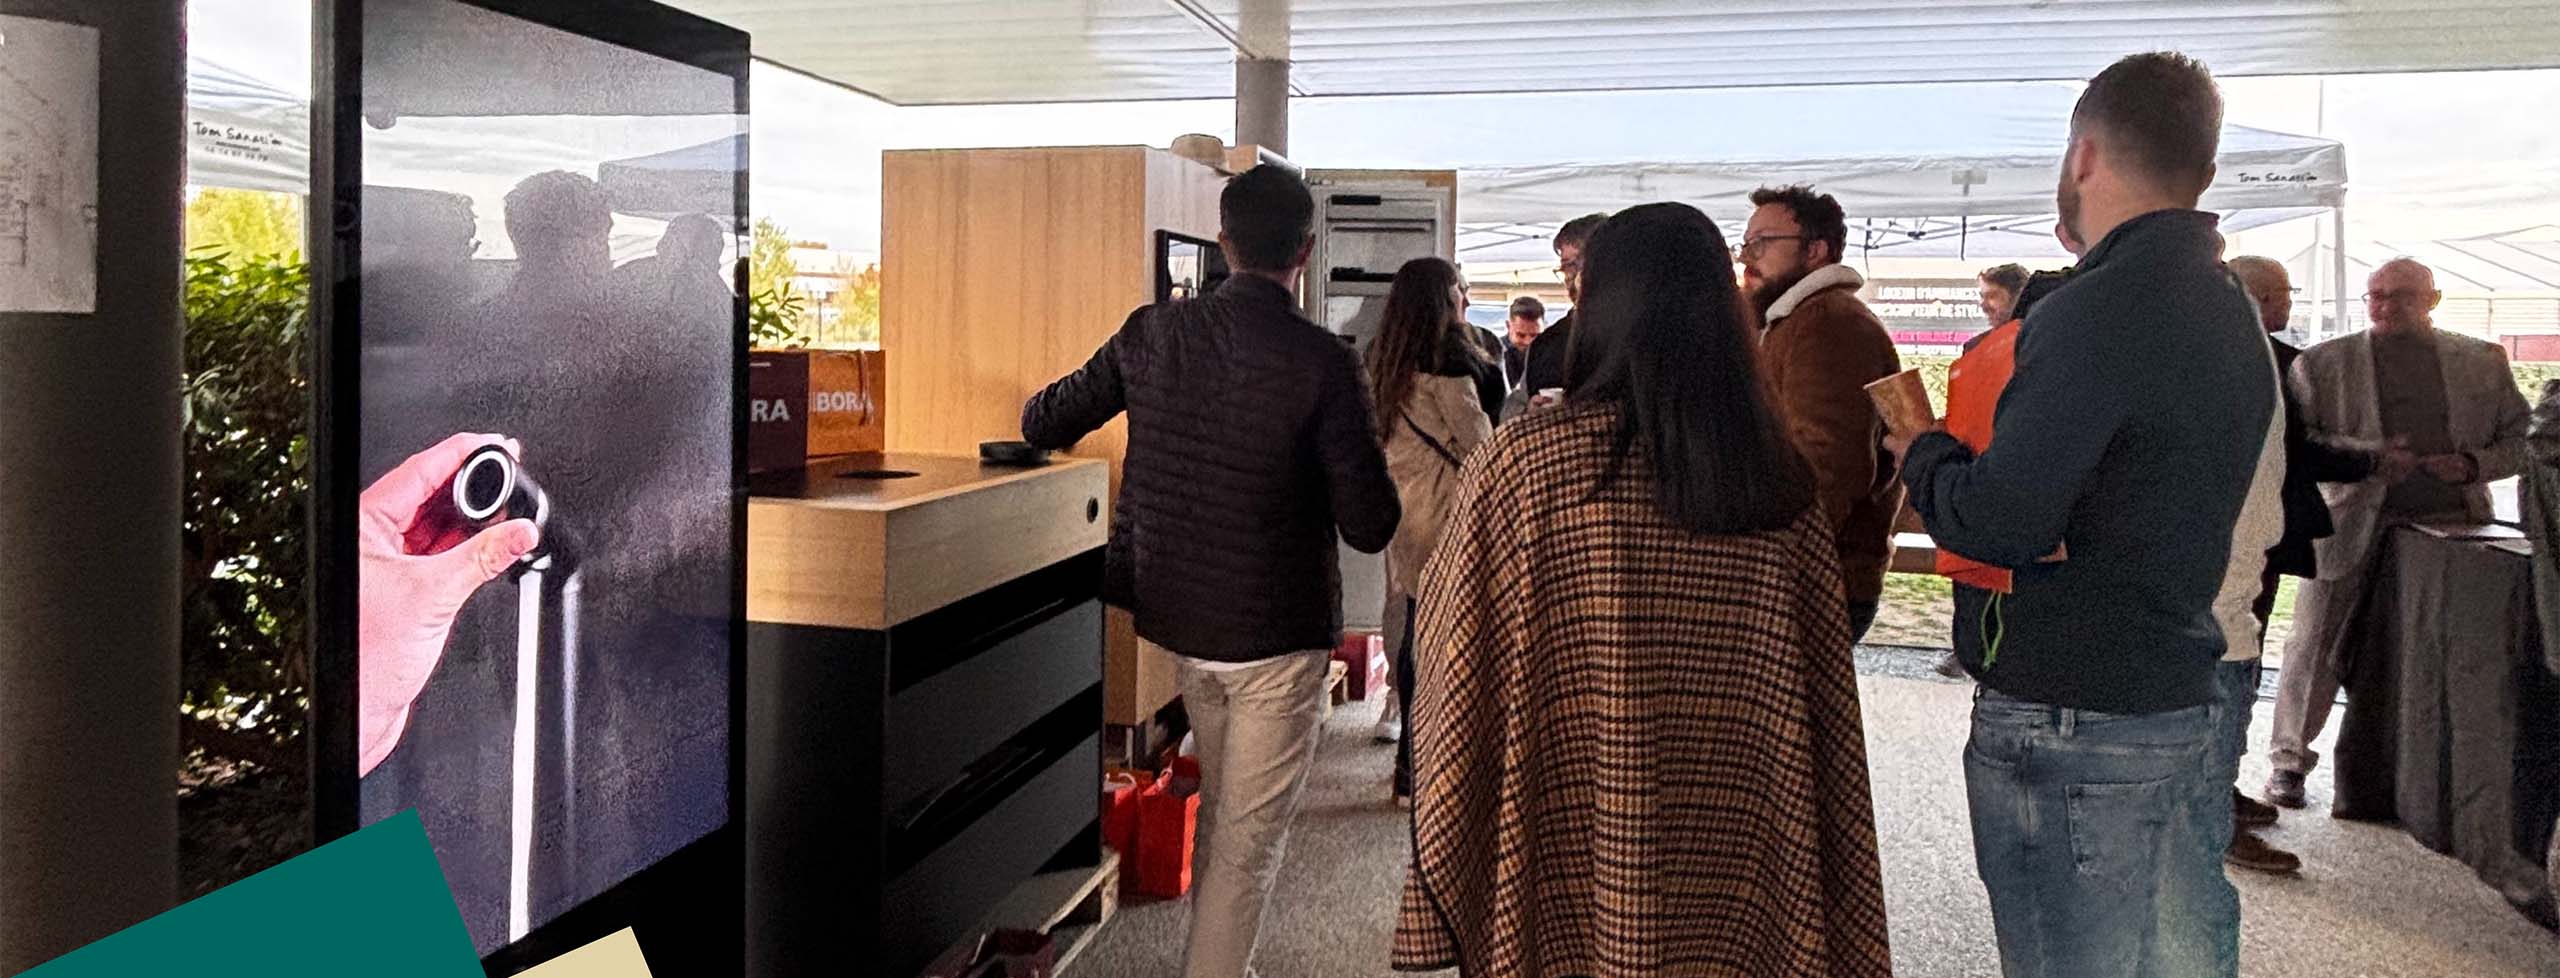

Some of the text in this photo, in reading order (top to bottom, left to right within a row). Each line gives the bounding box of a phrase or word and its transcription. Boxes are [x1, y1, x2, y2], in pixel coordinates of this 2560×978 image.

[192, 121, 221, 136] Tom
[2238, 172, 2260, 182] Tom
[751, 399, 790, 423] RA
